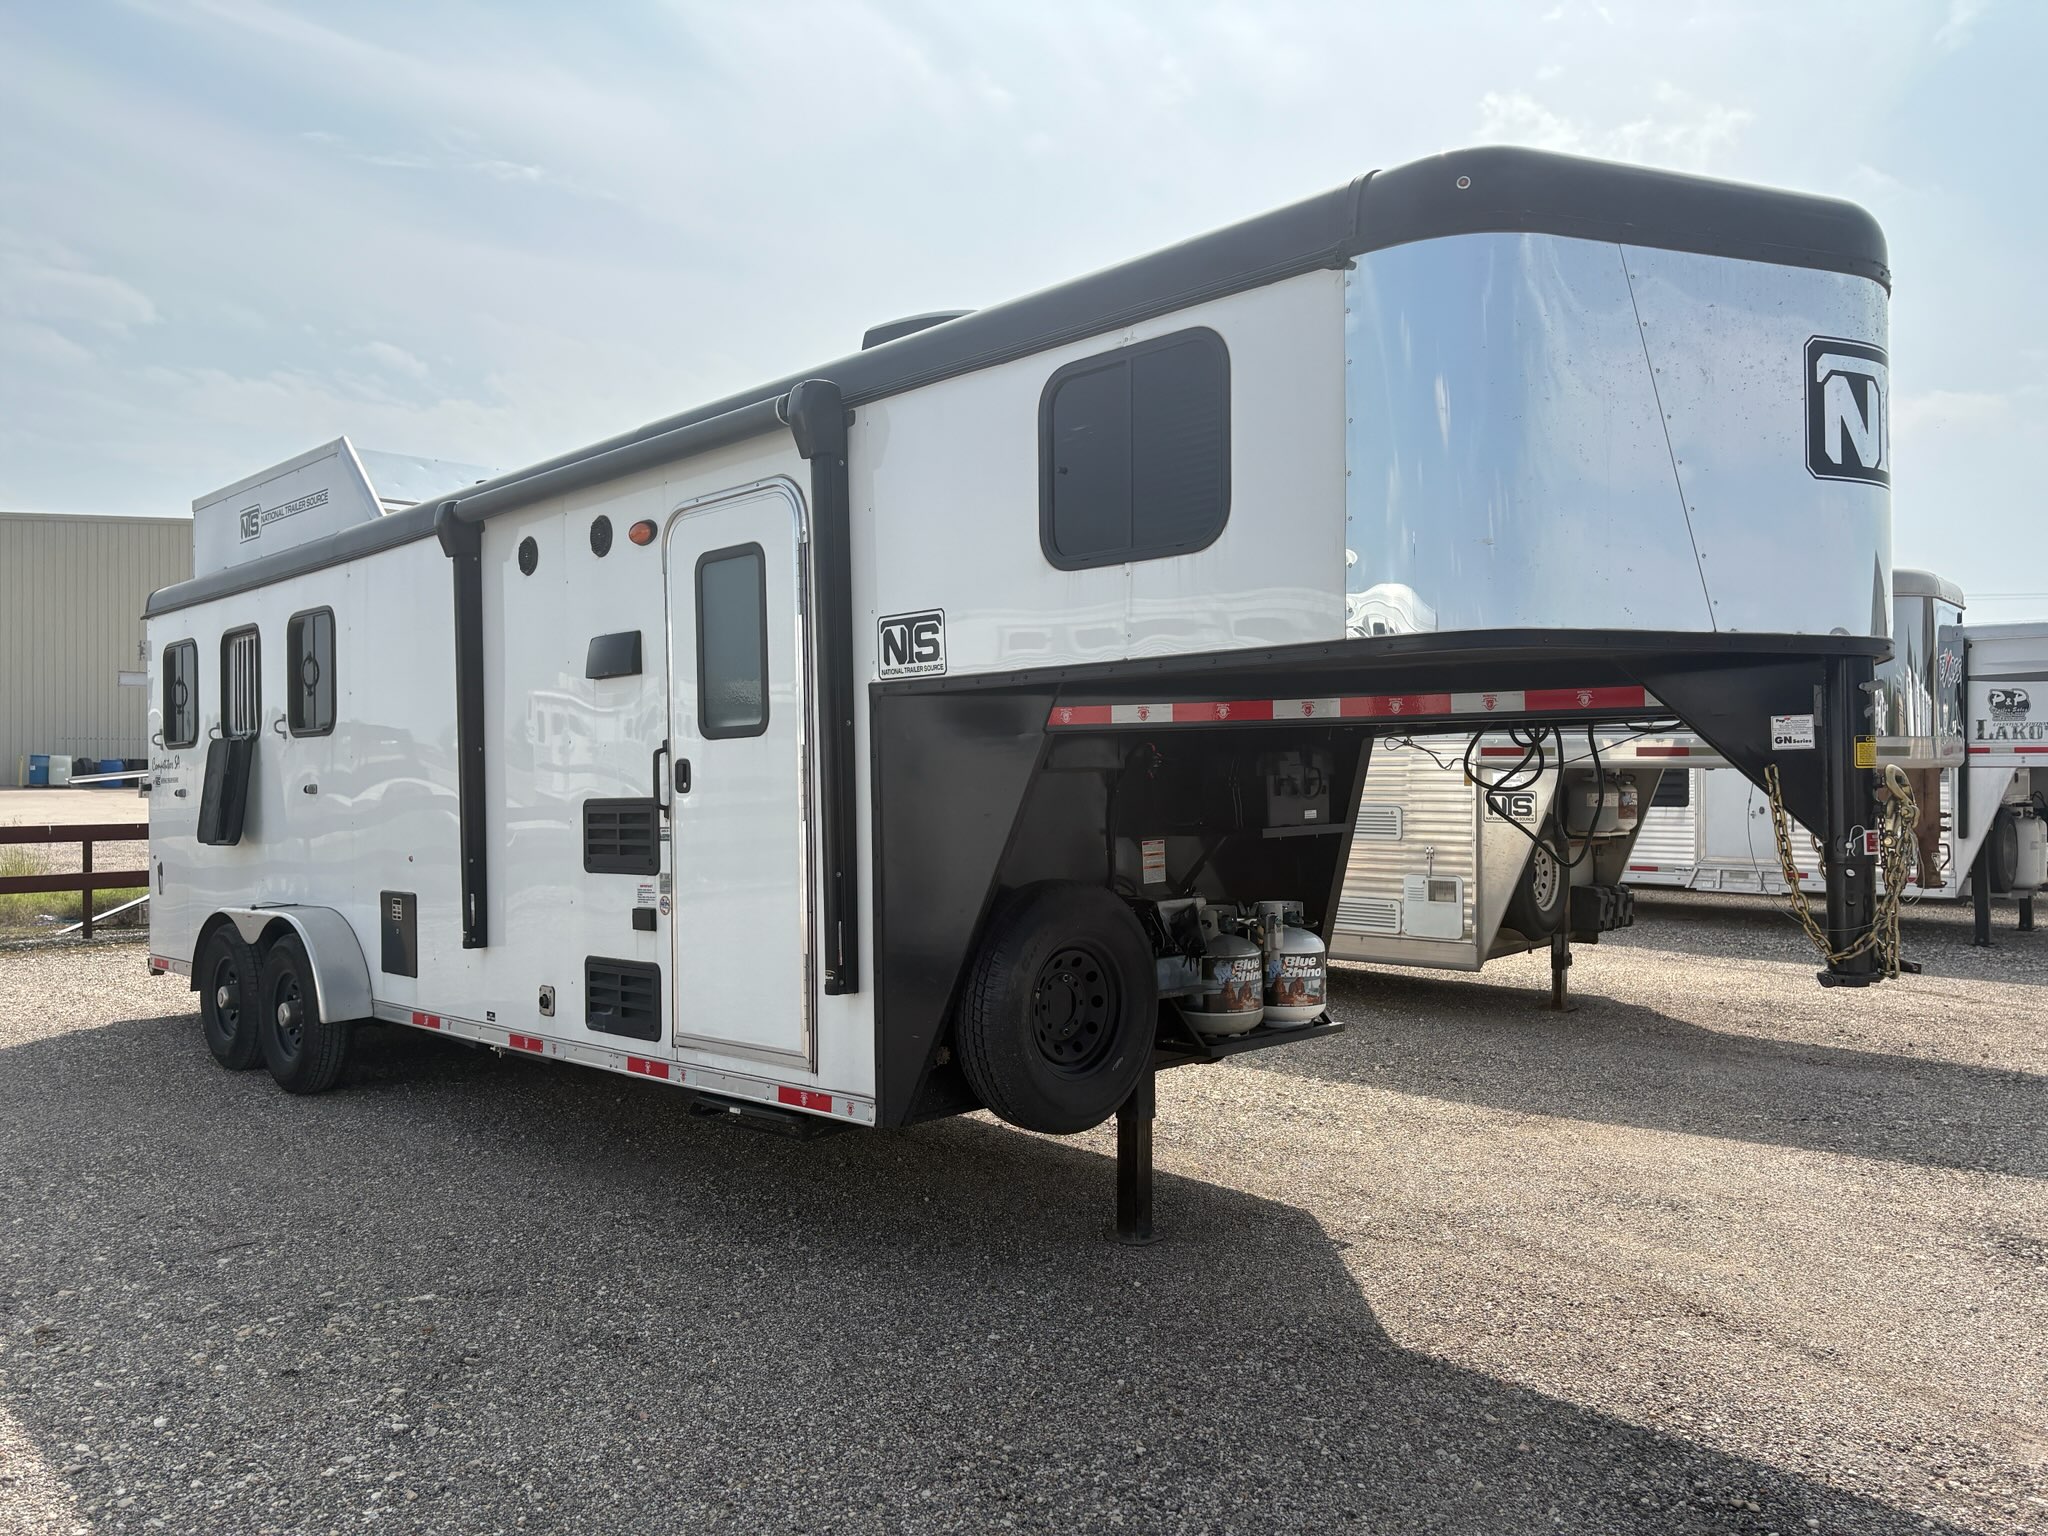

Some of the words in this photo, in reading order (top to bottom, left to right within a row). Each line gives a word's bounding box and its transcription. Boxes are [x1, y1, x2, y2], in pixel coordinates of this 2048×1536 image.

[261, 511, 284, 524] NATIONAL
[285, 501, 305, 514] TRAILER
[306, 492, 328, 507] SOURCE
[240, 508, 259, 540] NTS
[880, 614, 941, 666] NTS
[881, 667, 904, 676] NATIONAL
[904, 665, 924, 674] TRAILER
[923, 663, 944, 672] SOURCE
[1991, 690, 2027, 706] P&P
[1975, 719, 2048, 740] LAKO
[1774, 735, 1793, 745] GN
[1283, 956, 1317, 967] Blue
[1280, 966, 1322, 978] Rhino
